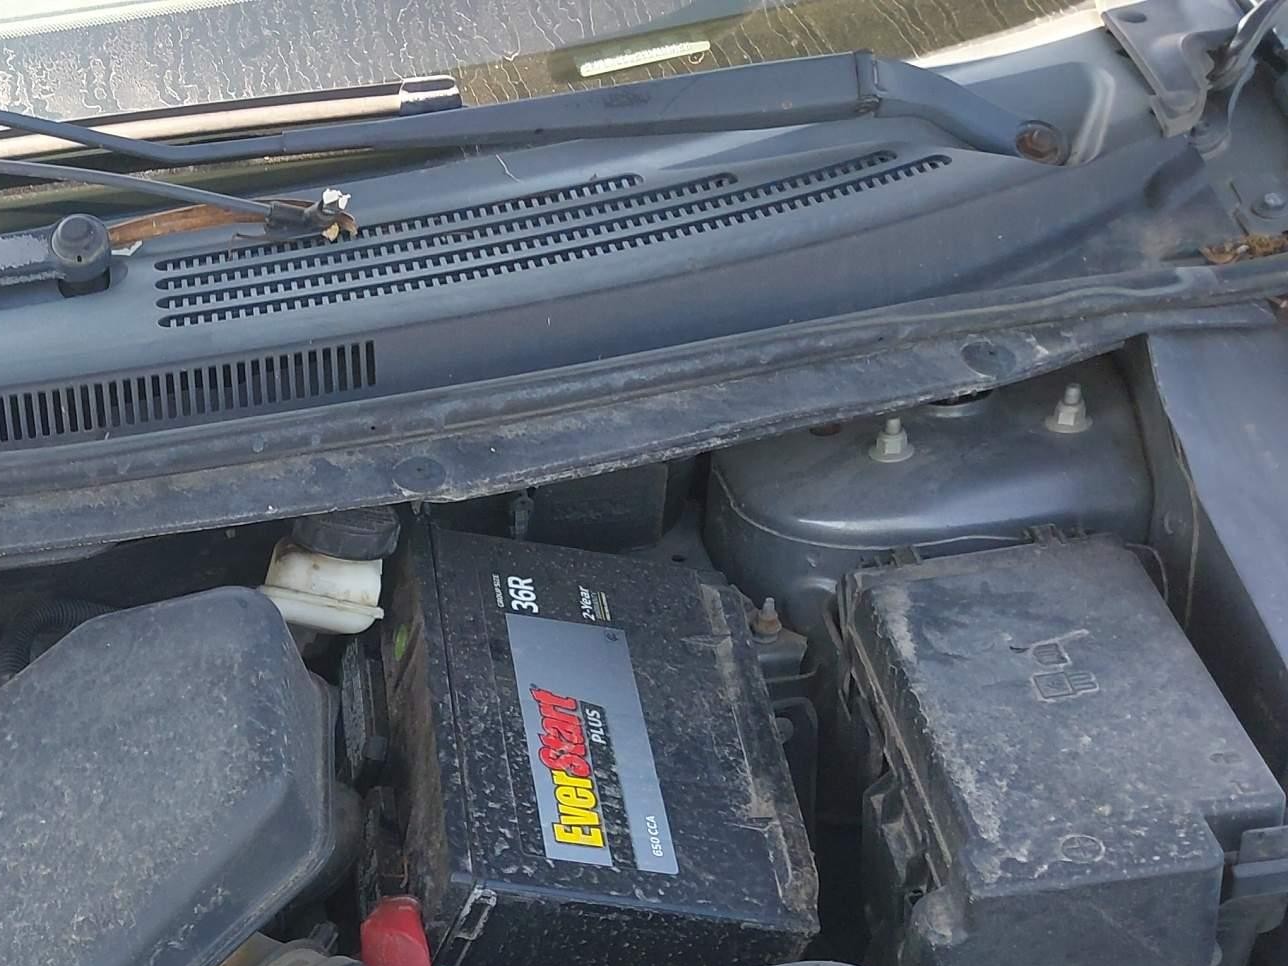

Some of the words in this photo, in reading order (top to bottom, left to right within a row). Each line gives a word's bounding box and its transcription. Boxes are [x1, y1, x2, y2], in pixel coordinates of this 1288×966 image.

[507, 575, 539, 613] 36R
[578, 584, 596, 621] 2-Year
[585, 707, 608, 745] PLUS
[529, 687, 607, 849] EverStart
[645, 815, 660, 836] CCA
[649, 834, 663, 858] 650
